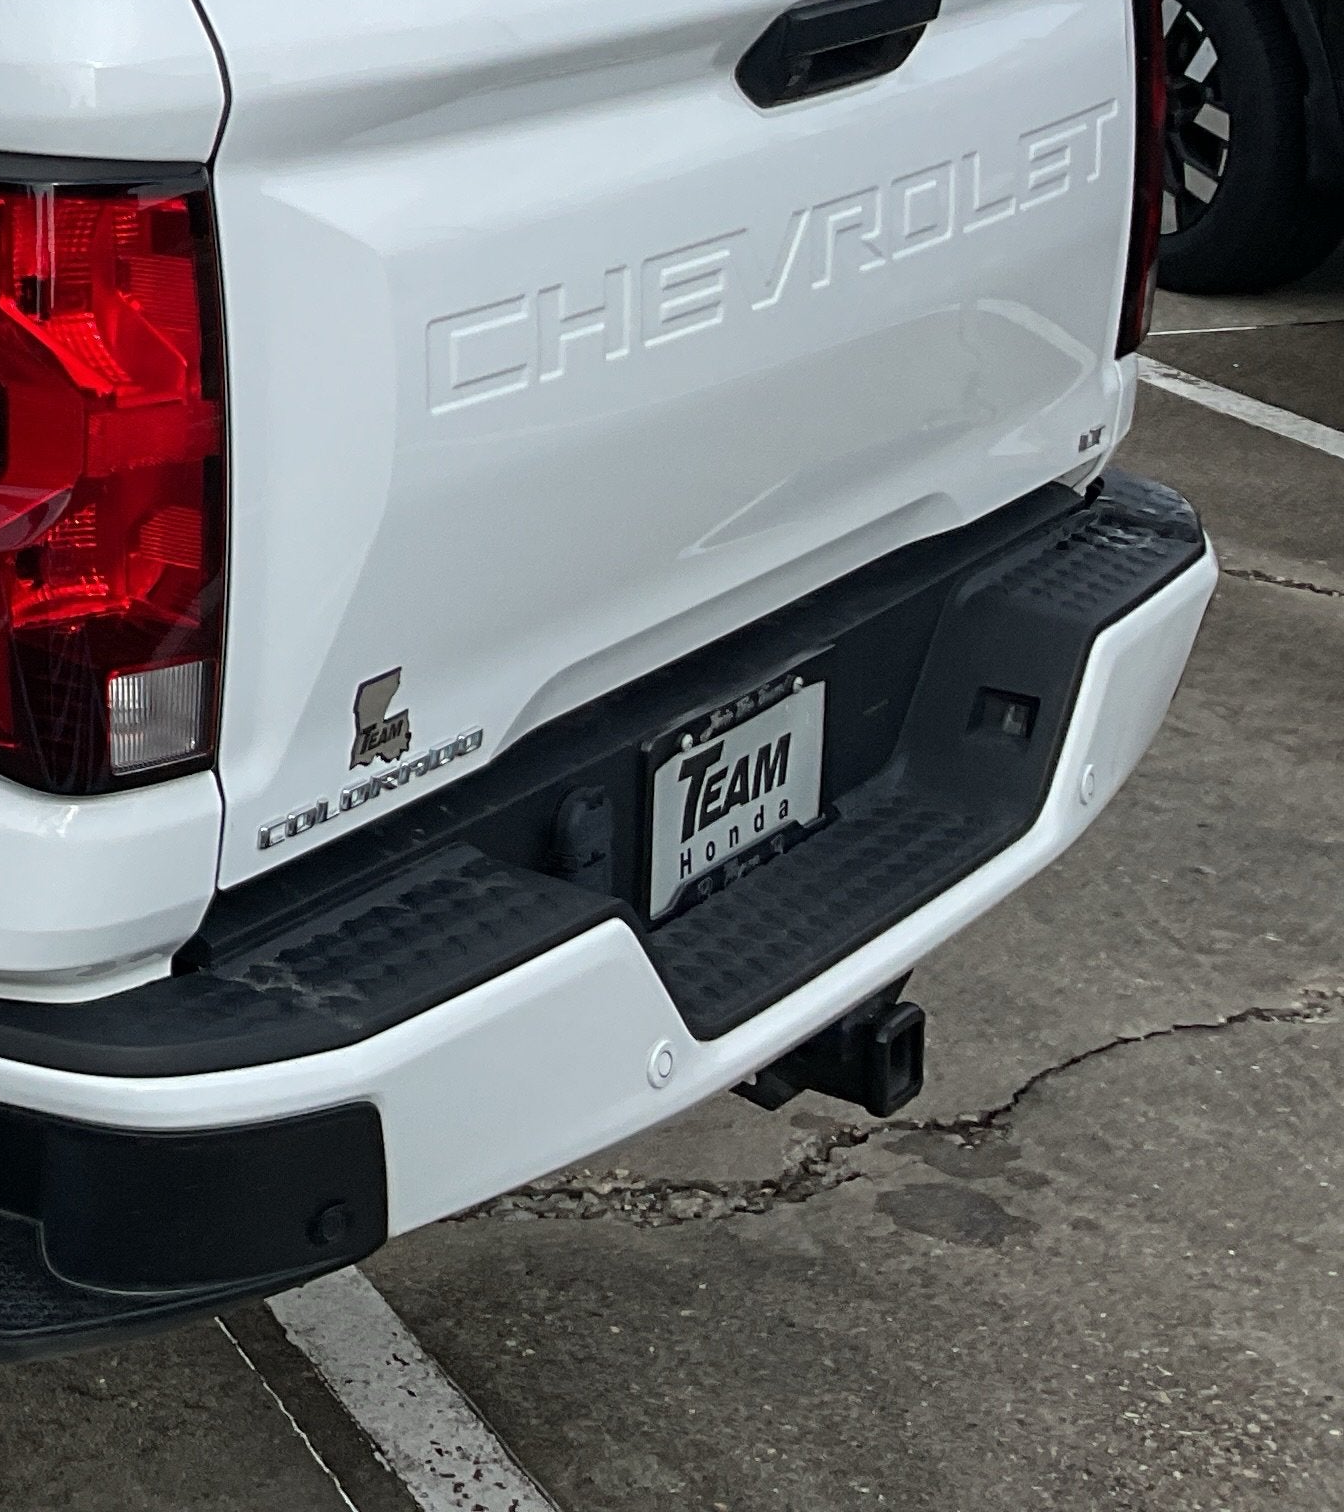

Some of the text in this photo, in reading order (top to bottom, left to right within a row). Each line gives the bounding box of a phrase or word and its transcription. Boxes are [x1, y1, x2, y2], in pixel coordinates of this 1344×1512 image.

[424, 96, 1118, 416] CHEVROLET
[257, 726, 484, 851] COLORADO
[680, 798, 789, 880] Honda
